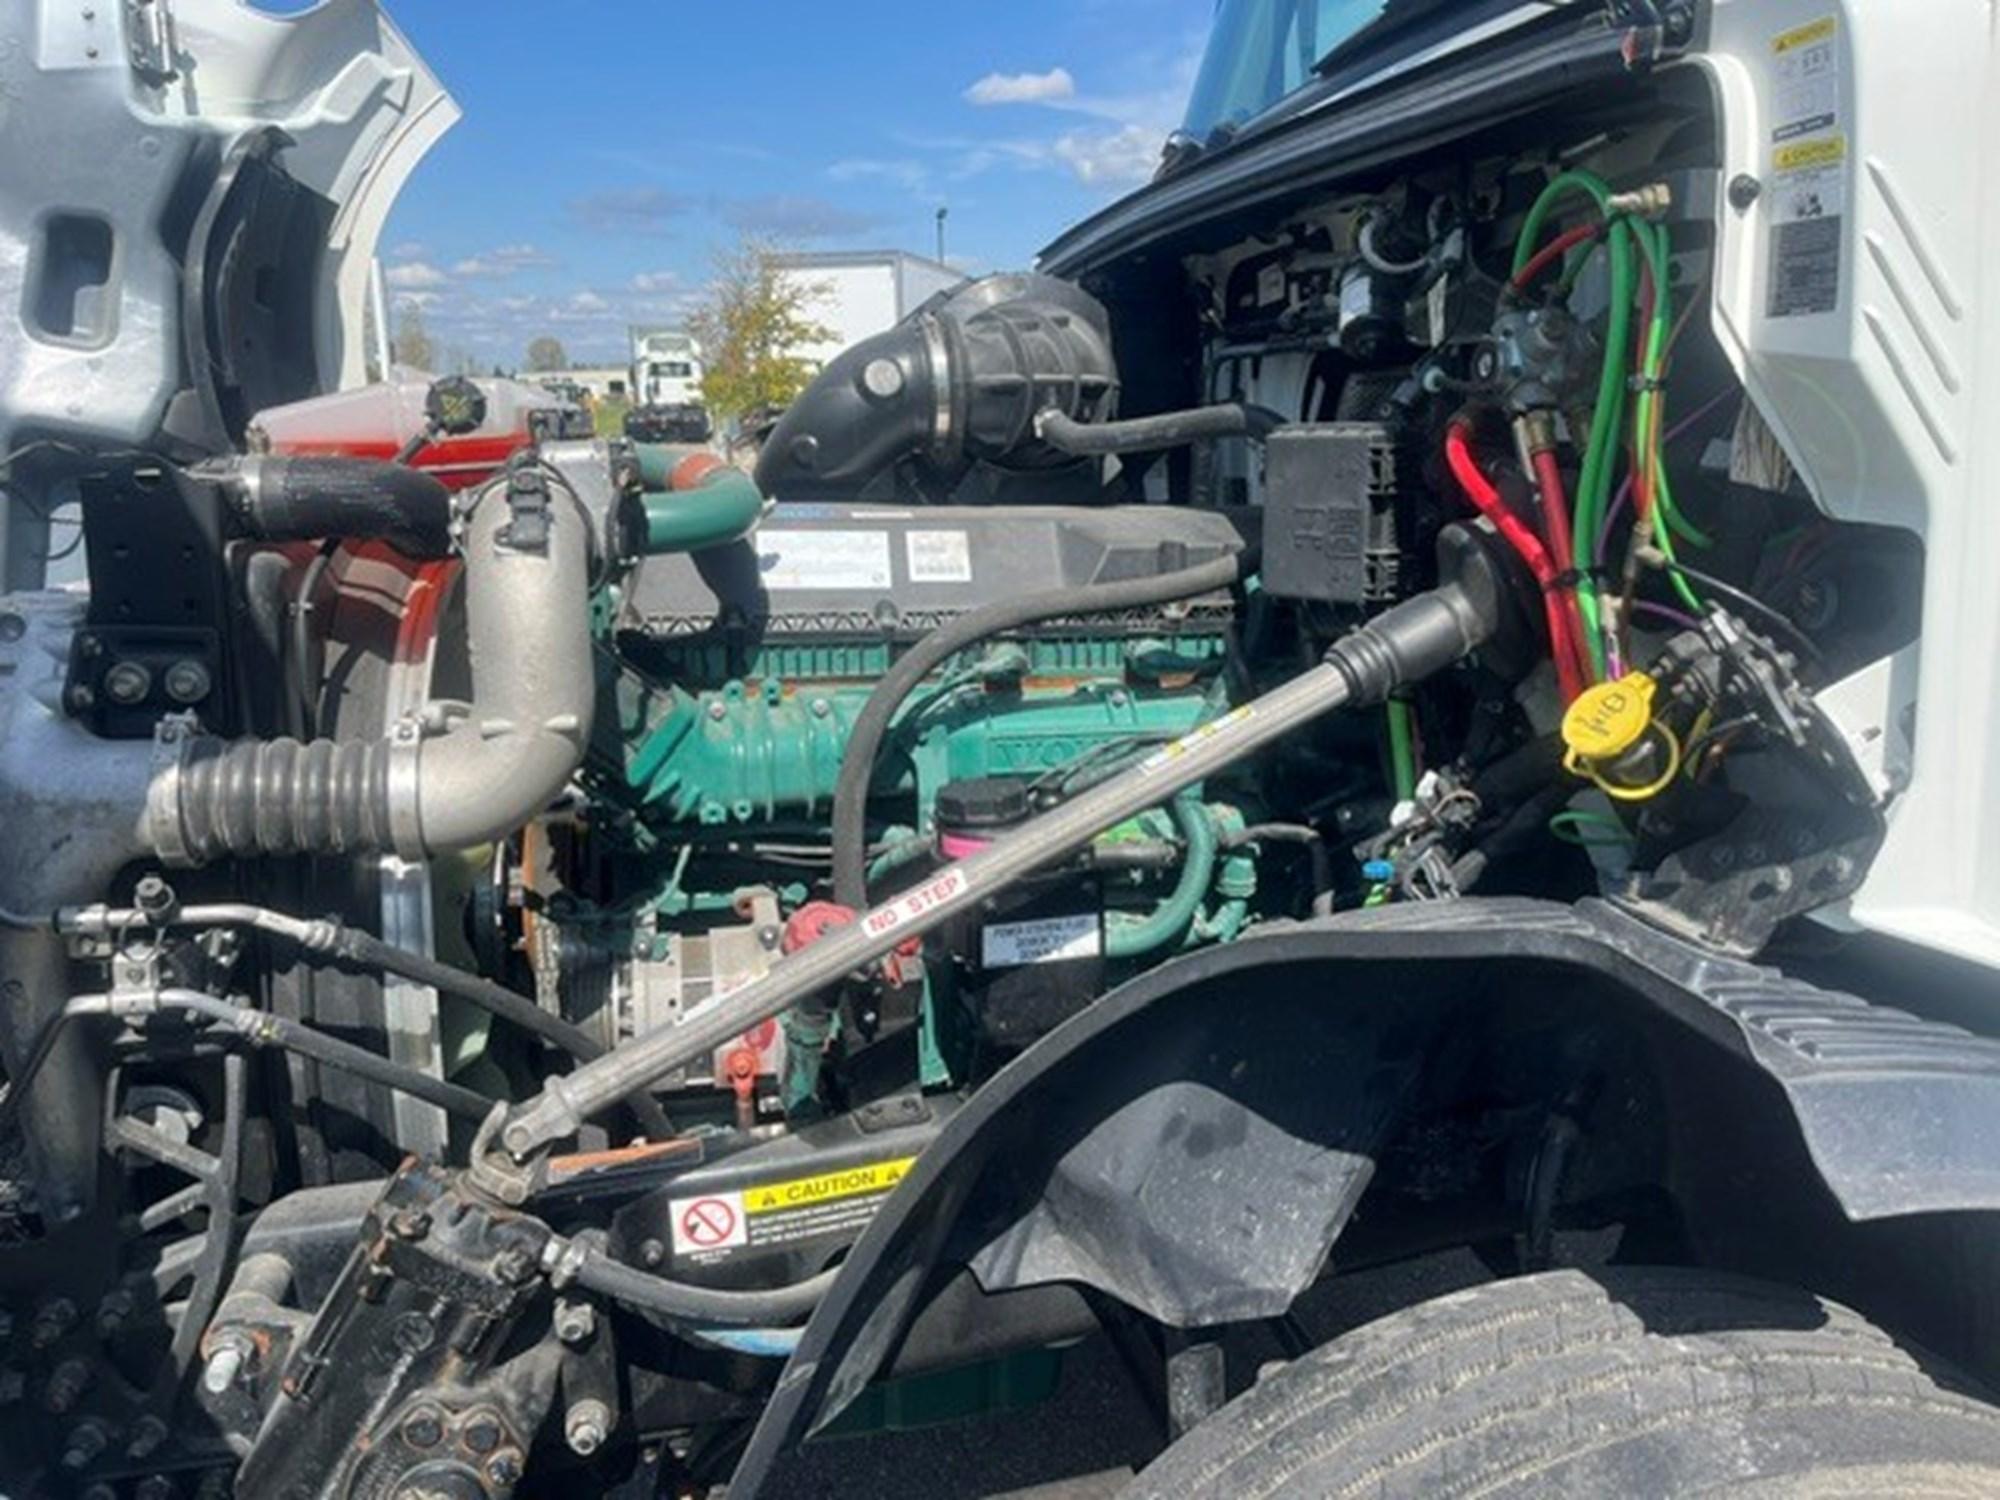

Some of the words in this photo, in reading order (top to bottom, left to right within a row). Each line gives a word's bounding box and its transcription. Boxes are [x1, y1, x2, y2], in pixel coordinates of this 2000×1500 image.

[868, 909, 898, 931] NO
[907, 876, 957, 912] STEP
[787, 1171, 876, 1200] CAUTION
